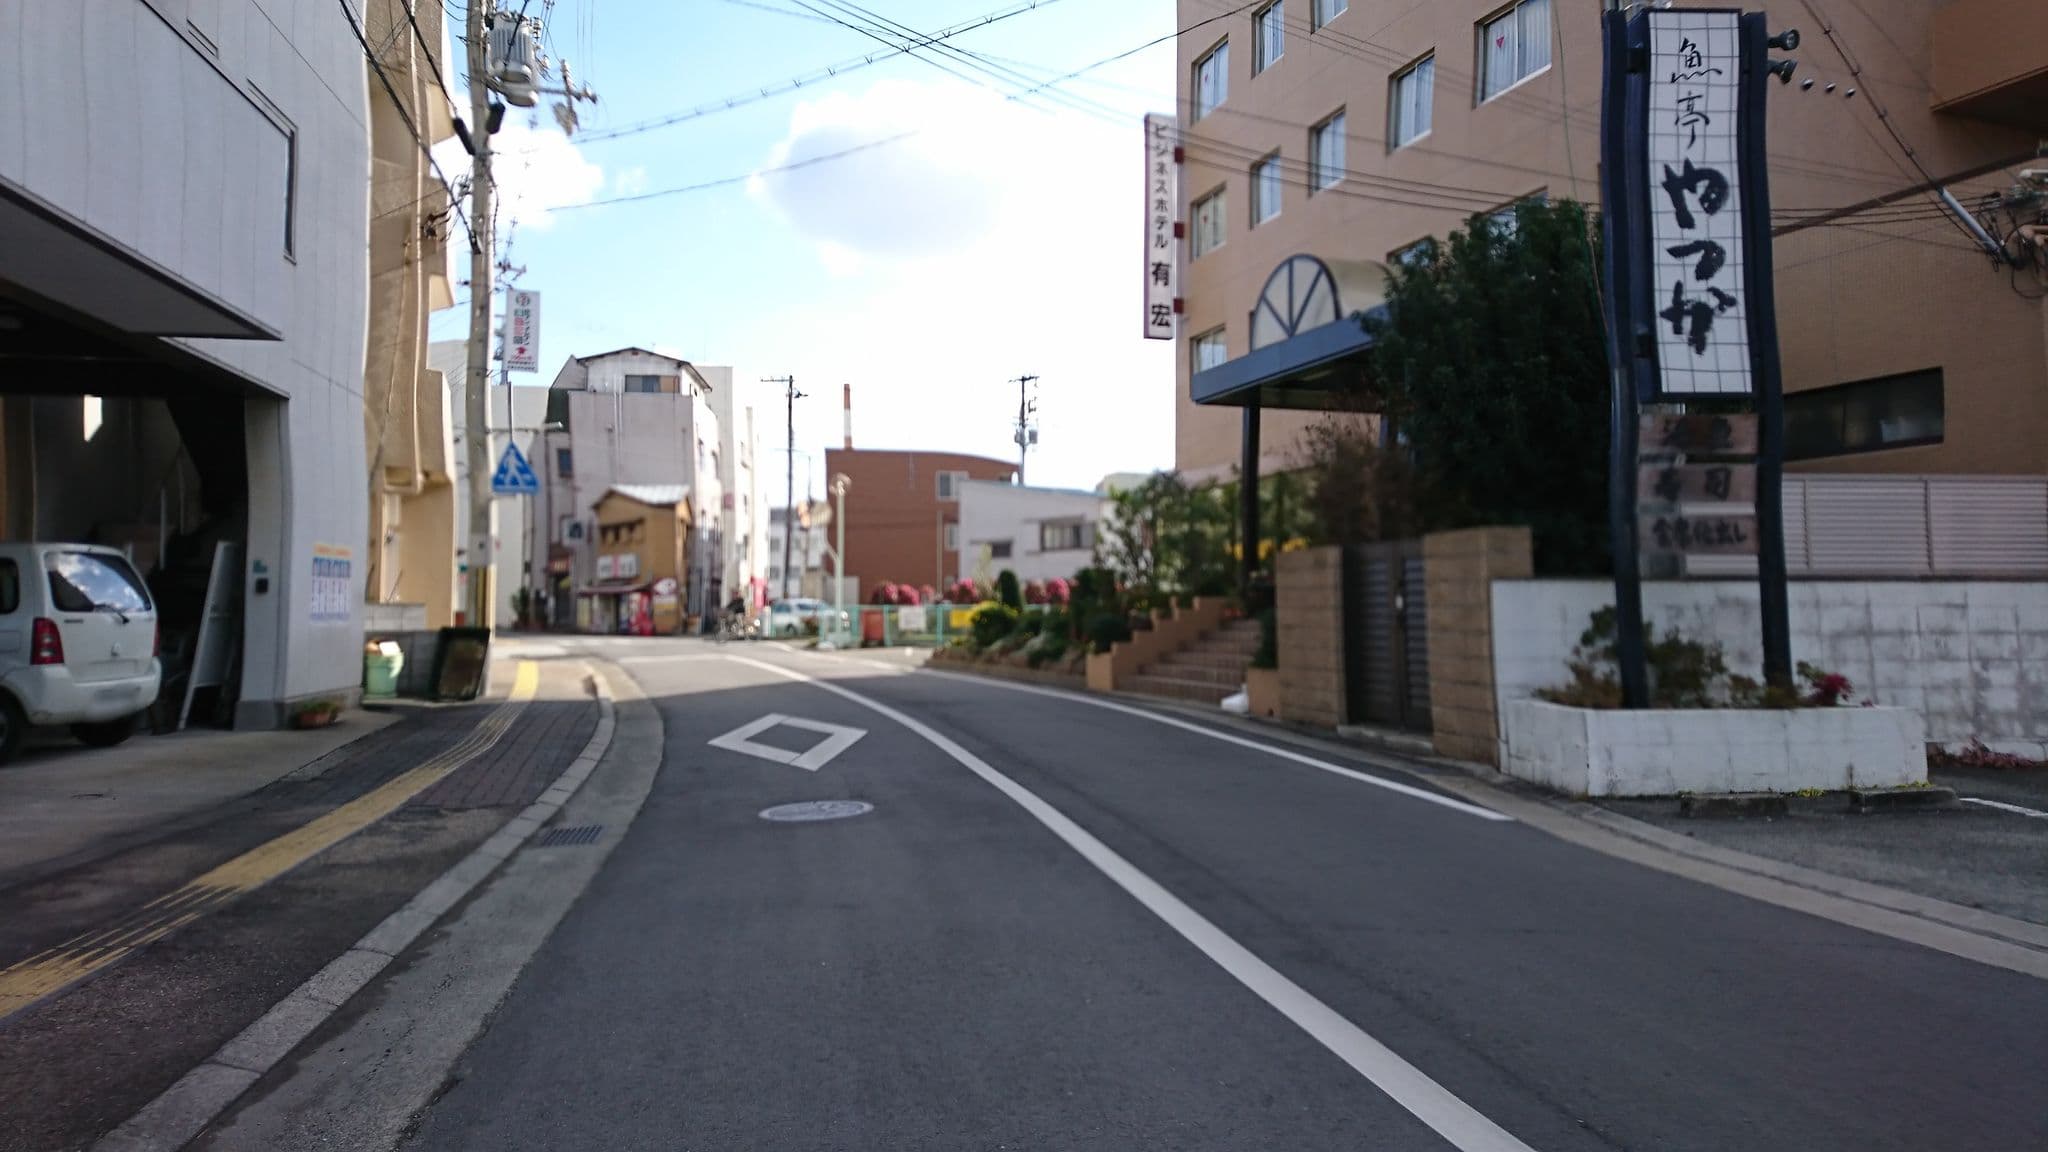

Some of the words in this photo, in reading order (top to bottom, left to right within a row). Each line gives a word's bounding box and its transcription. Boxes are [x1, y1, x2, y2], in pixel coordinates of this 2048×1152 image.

[1153, 123, 1169, 249] ビジネスホテル
